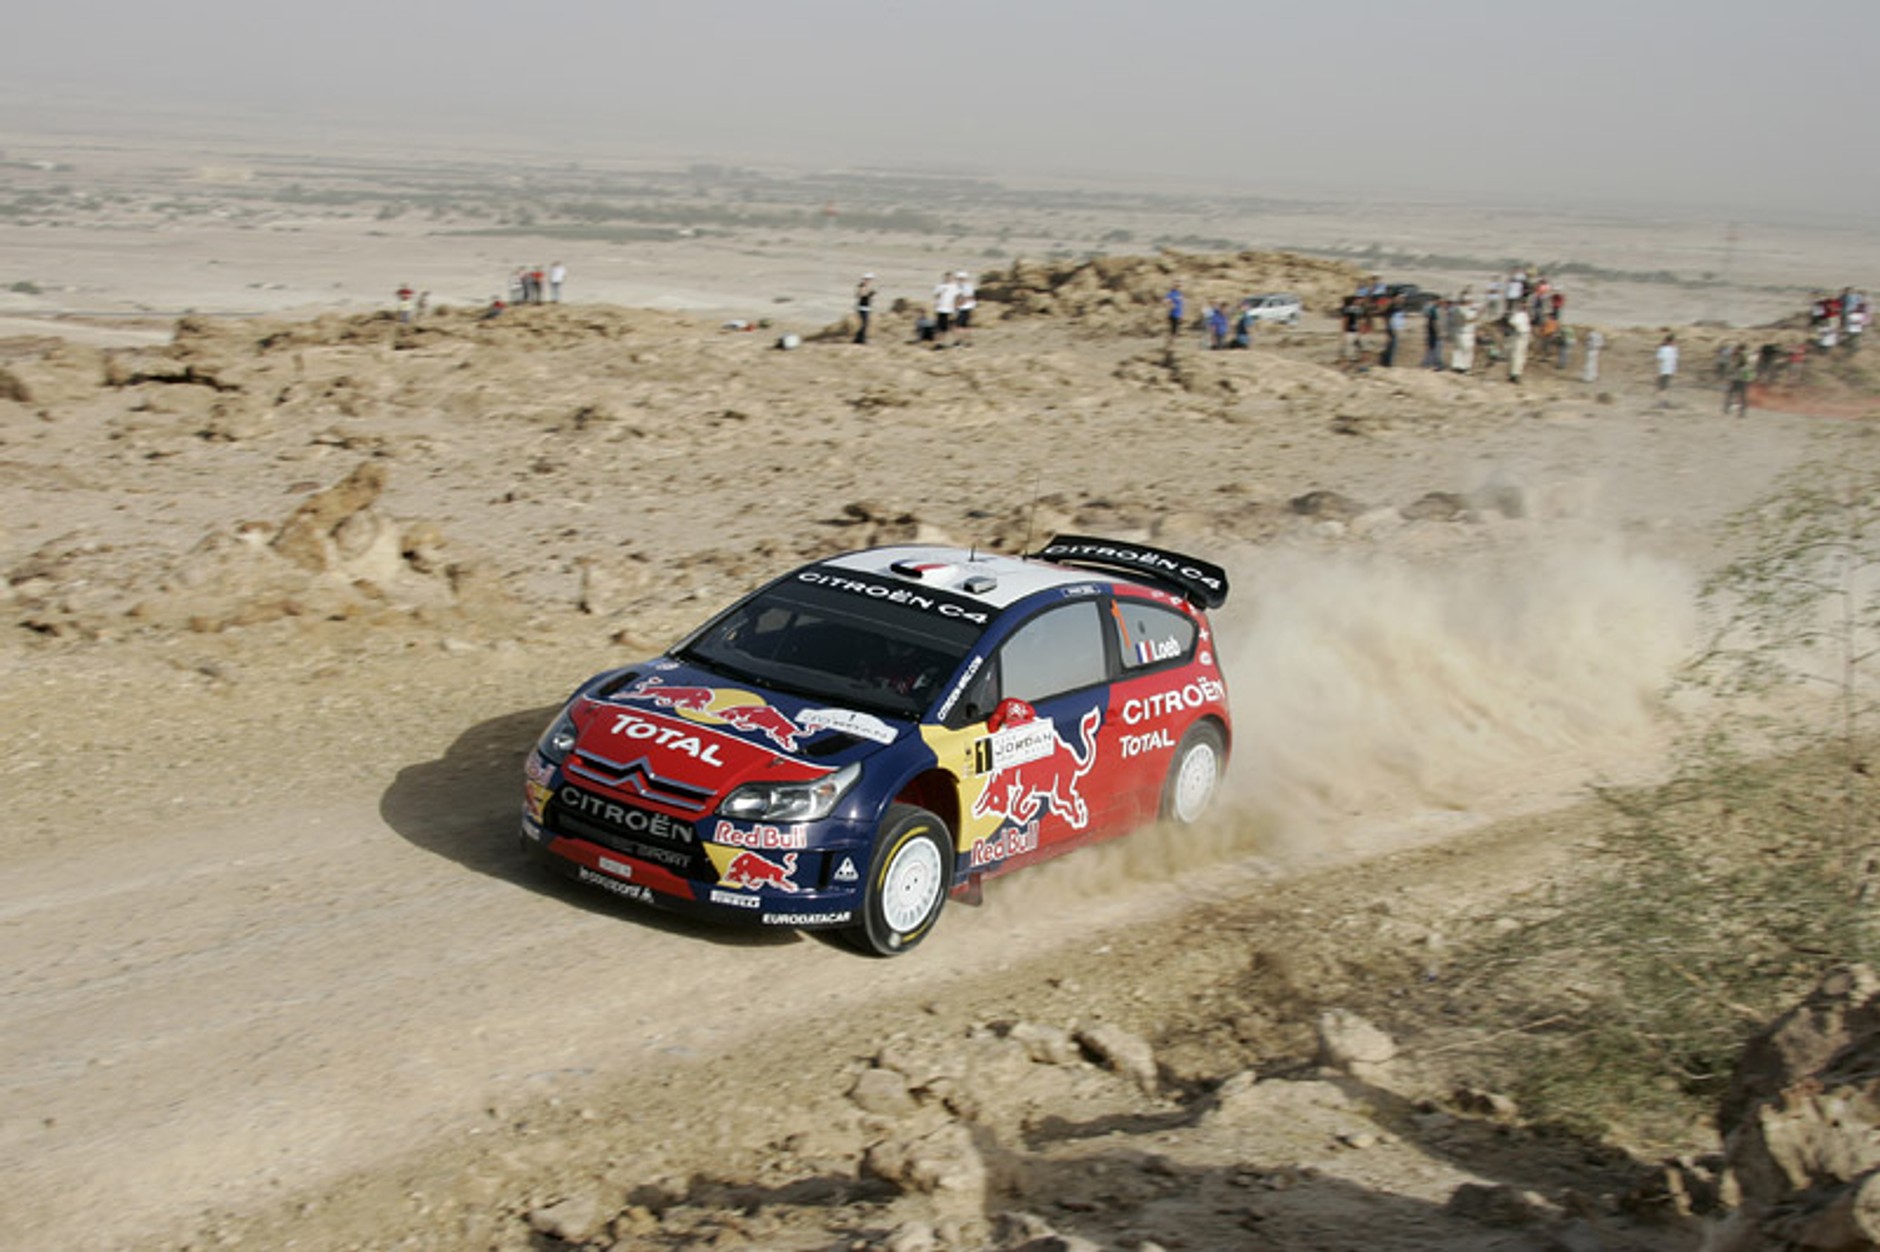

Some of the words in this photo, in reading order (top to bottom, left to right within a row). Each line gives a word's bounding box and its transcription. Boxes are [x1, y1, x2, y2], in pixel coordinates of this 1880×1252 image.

[1044, 545, 1178, 570] CITROËN
[1180, 567, 1221, 589] C4
[798, 572, 933, 609] CITROËN
[938, 604, 988, 624] C4
[1151, 635, 1181, 660] Loeb
[611, 714, 724, 767] TOTAL
[1119, 728, 1175, 760] TOTAL
[561, 786, 693, 843] CITROËN
[713, 820, 761, 848] Red
[762, 823, 808, 849] Bull
[970, 828, 1007, 867] Red
[1007, 820, 1039, 856] Bull
